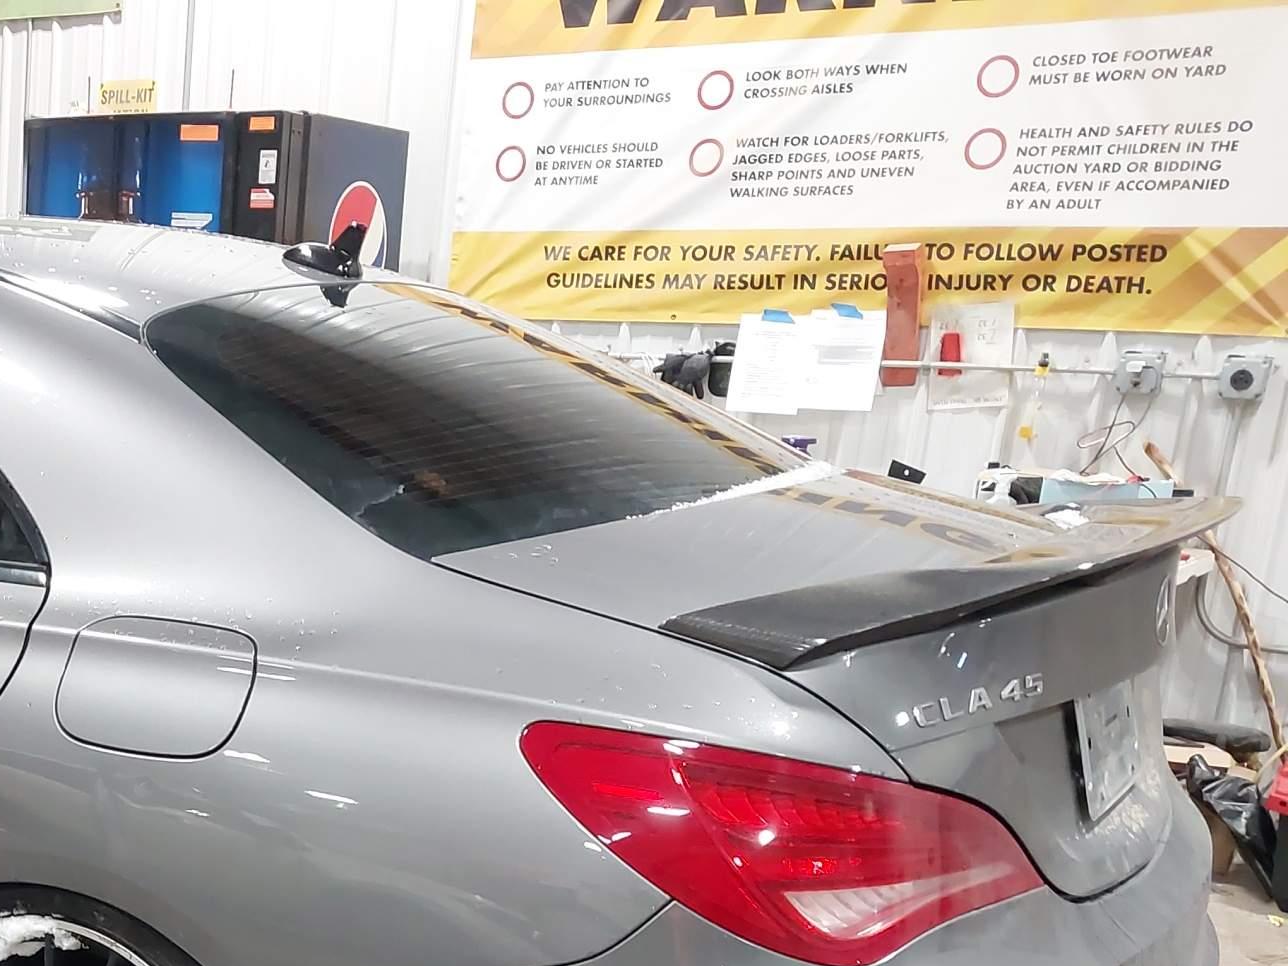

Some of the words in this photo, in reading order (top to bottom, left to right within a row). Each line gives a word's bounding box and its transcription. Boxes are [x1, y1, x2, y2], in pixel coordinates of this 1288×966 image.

[1033, 54, 1086, 67] CLOSED
[1092, 52, 1118, 64] TOE
[1124, 46, 1213, 61] FOOTWEAR
[746, 71, 781, 81] LOOK
[786, 69, 819, 80] BOTH
[825, 65, 860, 76] WAYS
[866, 64, 907, 74] WHEN
[1029, 73, 1068, 85] MUST
[1073, 72, 1089, 83] BE
[1096, 69, 1145, 82] WORN
[1152, 67, 1177, 79] ON
[1185, 65, 1226, 77] YARD
[545, 82, 564, 92] PAY
[568, 79, 629, 90] ATTENTION
[635, 77, 649, 87] TO
[744, 86, 806, 99] CROSSING
[812, 83, 853, 94] AISLES
[101, 88, 154, 105] SPILL-KIT
[544, 98, 572, 107] YOUR
[577, 93, 670, 106] SURROUNDINGS
[1020, 128, 1072, 138] HEALTH
[1077, 126, 1110, 137] AND
[1116, 124, 1169, 136] SAFETY
[1175, 122, 1221, 134] RULES
[1228, 121, 1253, 132] DO
[737, 137, 779, 147] WATCH
[784, 136, 809, 146] FOR
[814, 131, 948, 145] LOADERS/FORKLIFTS,
[537, 145, 555, 154] NO
[560, 144, 607, 154] VEHICLES
[612, 142, 658, 152] SHOULD
[1017, 146, 1047, 156] NOT
[1051, 145, 1102, 156] PERMIT
[1108, 143, 1181, 154] CHILDREN
[1187, 142, 1204, 152] IN
[1212, 141, 1239, 152] THE
[536, 161, 548, 170] BE
[552, 160, 592, 170] DRIVEN
[596, 160, 611, 168] OR
[616, 158, 663, 168] STARTED
[733, 154, 783, 165] JAGGED
[788, 153, 829, 164] EDGES,
[836, 151, 876, 161] LOOSE
[881, 149, 923, 160] PARTS,
[731, 171, 773, 181] SHARP
[777, 169, 822, 180] POINTS
[827, 168, 855, 178] AND
[861, 167, 914, 177] UNEVEN
[1013, 163, 1077, 174] AUCTION
[1084, 163, 1121, 173] YARD
[1127, 162, 1148, 172] OR
[1154, 160, 1221, 172] BIDDING
[534, 177, 547, 186] AT
[551, 176, 598, 185] ANYTIME
[1010, 182, 1051, 193] AREA,
[1057, 181, 1093, 191] EVEN
[1099, 181, 1110, 191] IF
[1115, 179, 1229, 191] ACCOMPANIED
[730, 187, 788, 197] WALKING
[793, 185, 853, 196] SURFACES
[1007, 200, 1024, 209] BY
[1029, 200, 1050, 208] AN
[1056, 199, 1101, 209] ADULT
[544, 246, 571, 261] WE
[578, 246, 626, 261] CARE
[634, 246, 671, 261] FOR
[680, 245, 735, 261] YOUR
[743, 245, 820, 261] SAFETY.
[830, 244, 887, 260] FAILU
[925, 243, 954, 260] TO
[964, 243, 1064, 262] FOLLOW
[1072, 244, 1167, 262] POSTED
[547, 273, 655, 289] GUIDELINES
[662, 274, 707, 289] MAY
[713, 274, 786, 290] RESULT
[793, 274, 817, 289] IN
[825, 273, 887, 291] SERIO
[928, 274, 1014, 291] INJURY
[1022, 274, 1056, 292] OR
[1066, 275, 1151, 294] DEATH.
[913, 687, 993, 728] CLA
[1000, 673, 1044, 702] 45
